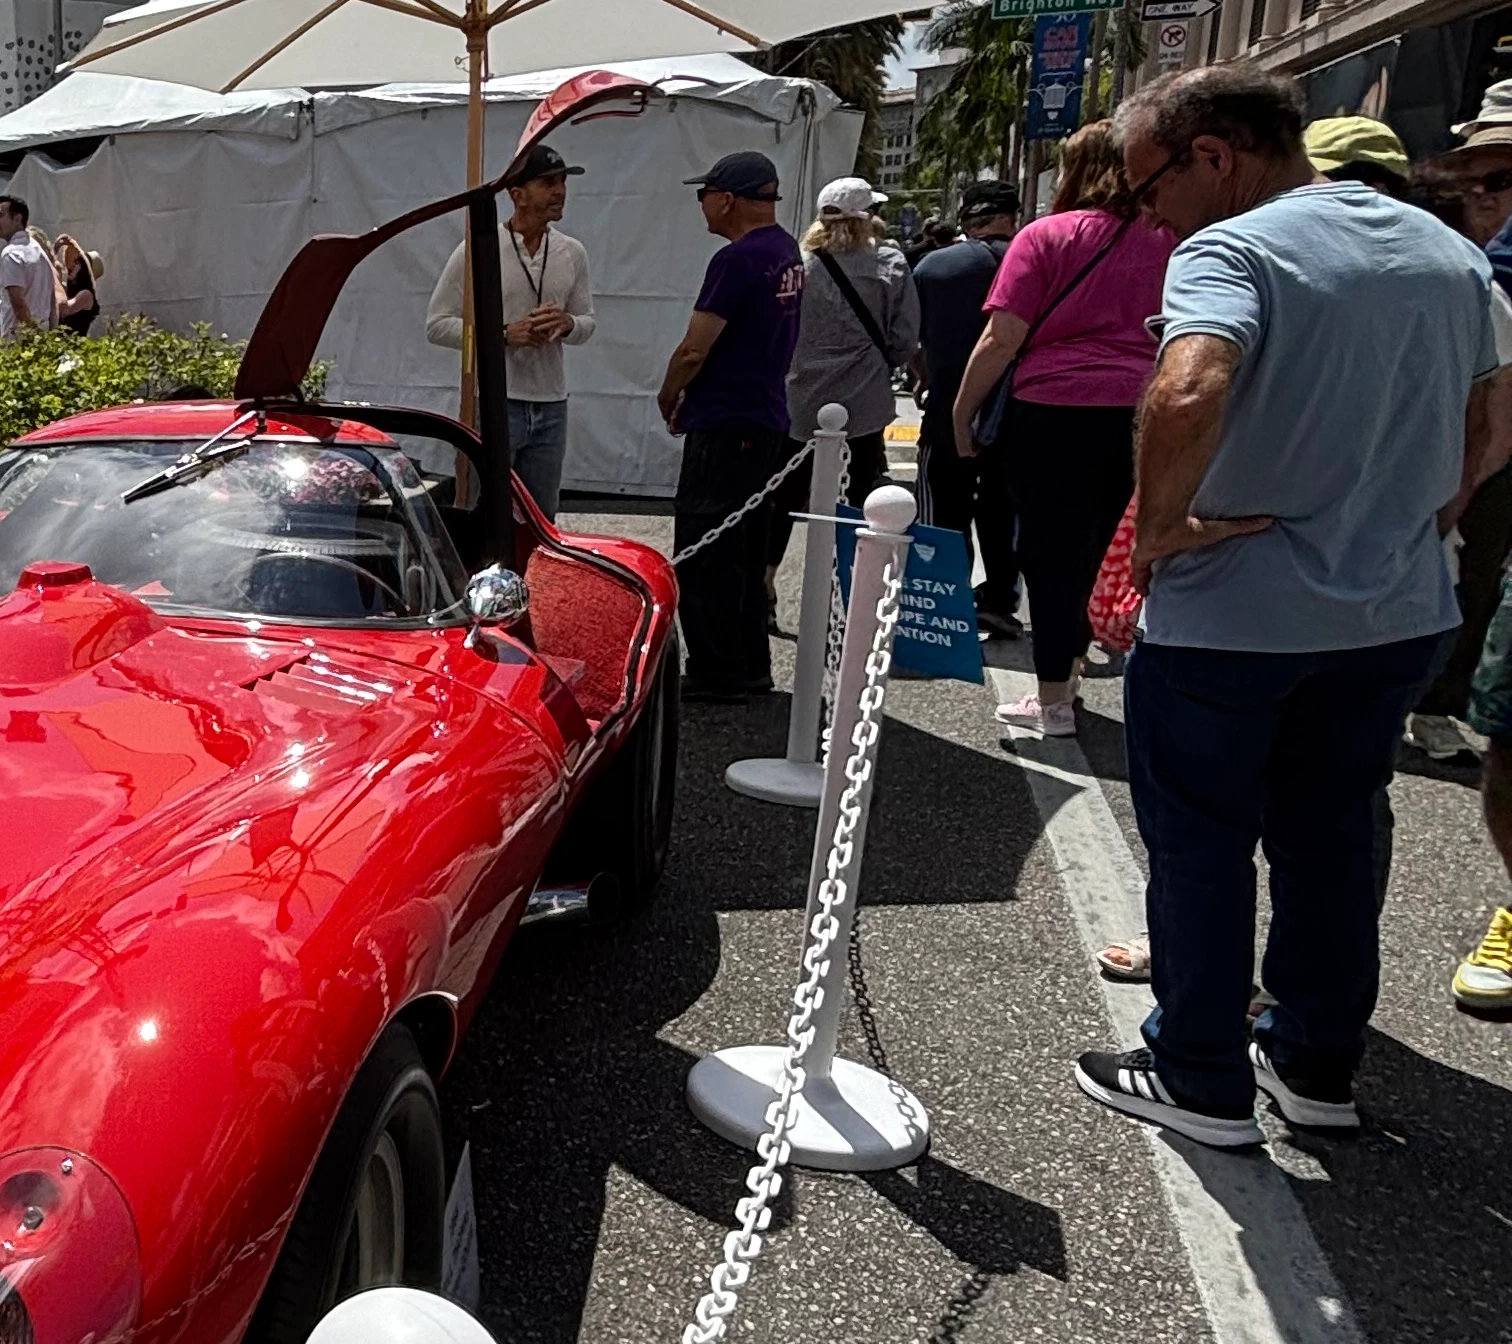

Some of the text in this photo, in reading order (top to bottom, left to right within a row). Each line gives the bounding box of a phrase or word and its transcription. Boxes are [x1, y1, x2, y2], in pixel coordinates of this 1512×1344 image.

[1148, 3, 1194, 14] ONE WAY
[912, 578, 957, 596] STAY
[930, 617, 970, 633] AND
